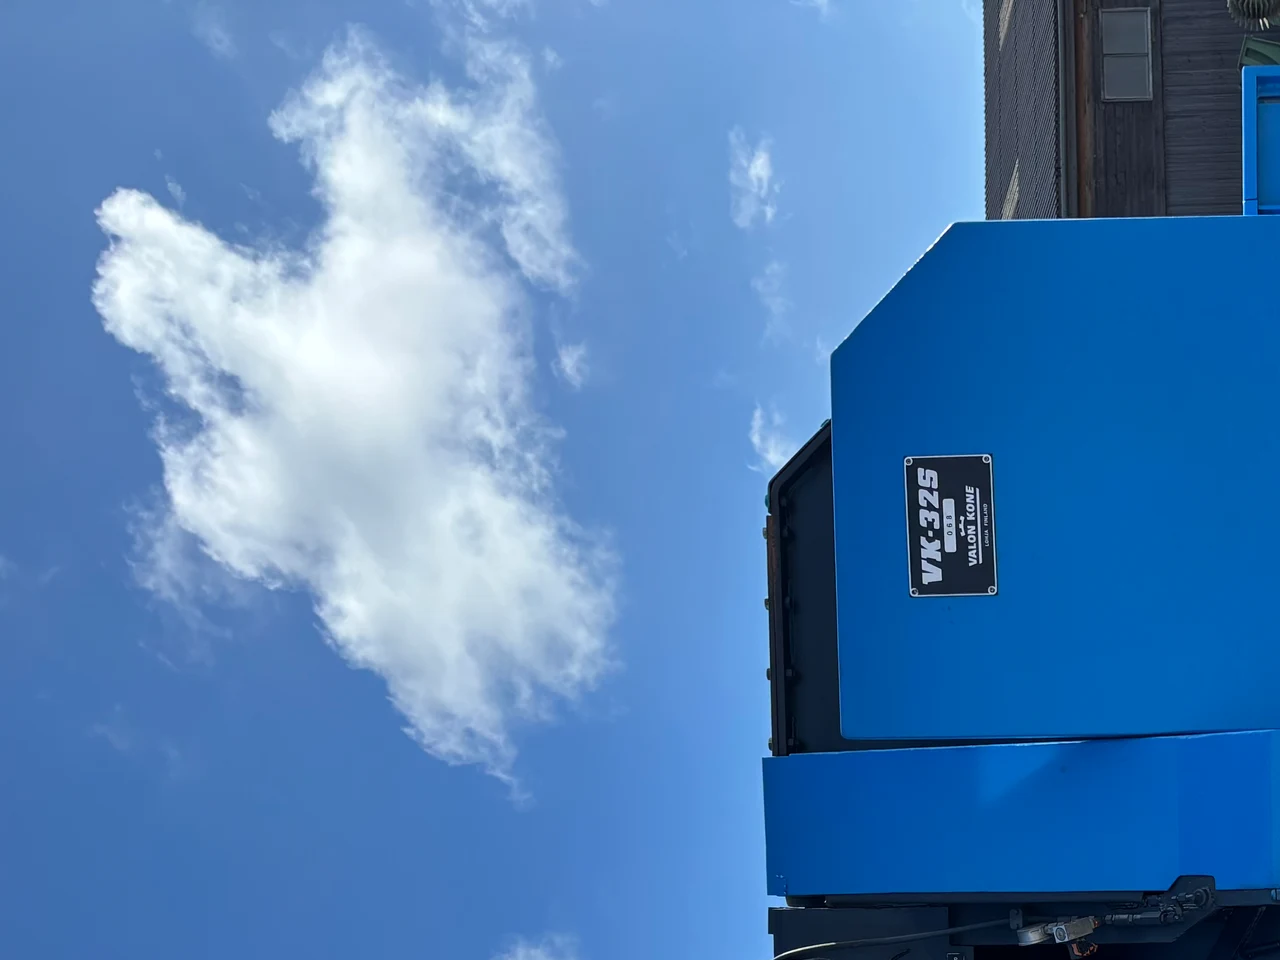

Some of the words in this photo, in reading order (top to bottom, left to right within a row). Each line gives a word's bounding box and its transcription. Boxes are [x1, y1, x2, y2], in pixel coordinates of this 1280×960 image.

[966, 486, 975, 520] KONE
[918, 467, 942, 585] VK-32S
[967, 526, 977, 566] VALON
